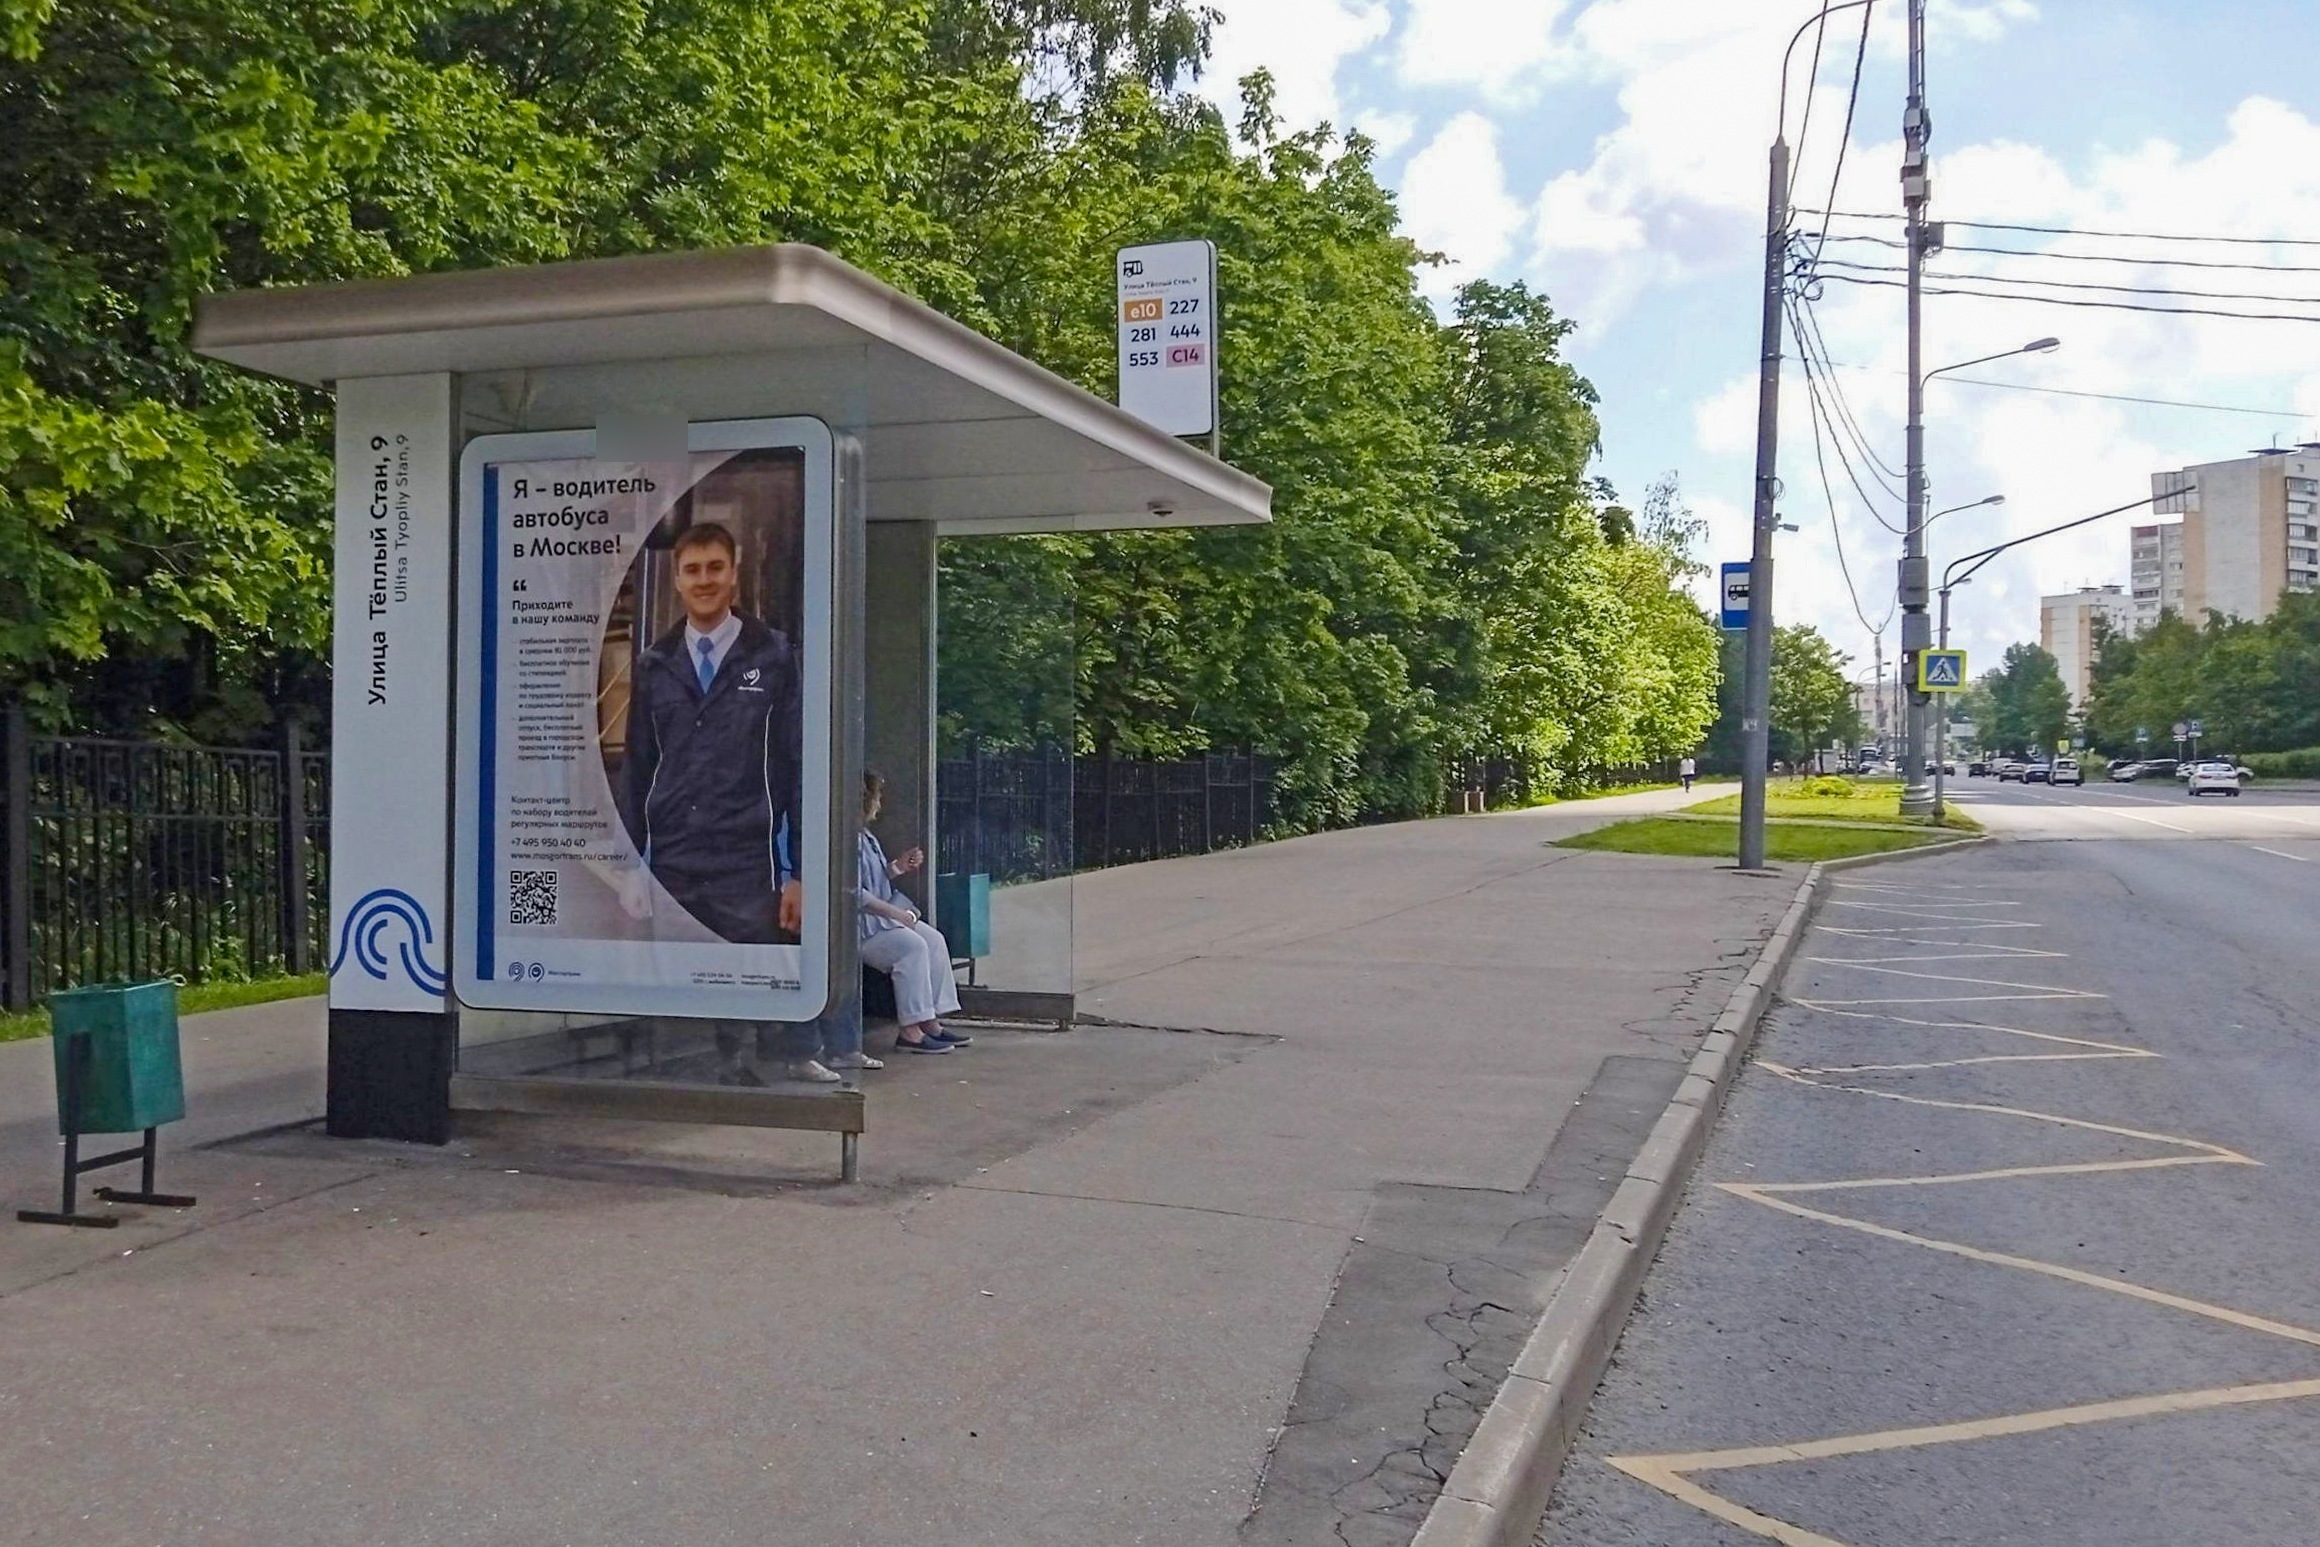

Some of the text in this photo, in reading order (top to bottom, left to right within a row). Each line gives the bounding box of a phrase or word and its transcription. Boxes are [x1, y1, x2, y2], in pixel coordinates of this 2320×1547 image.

[1170, 298, 1199, 314] 227
[1131, 324, 1200, 342] 281 444
[1129, 351, 1158, 367] 553
[513, 479, 528, 499] Я
[554, 478, 656, 499] водитель
[394, 490, 411, 550] Tyopliy
[513, 505, 609, 531] автобуса
[513, 534, 621, 558] в Москве!
[368, 435, 391, 705] Улица Тёплый Стан, 9
[395, 557, 408, 602] Ulitsa
[512, 600, 574, 613] Приходите
[512, 613, 600, 626] в нашу команду
[511, 795, 571, 805] Контакт-центр
[522, 838, 539, 848] 495
[541, 838, 558, 848] 950
[560, 838, 572, 848] 40
[574, 838, 586, 848] 40
